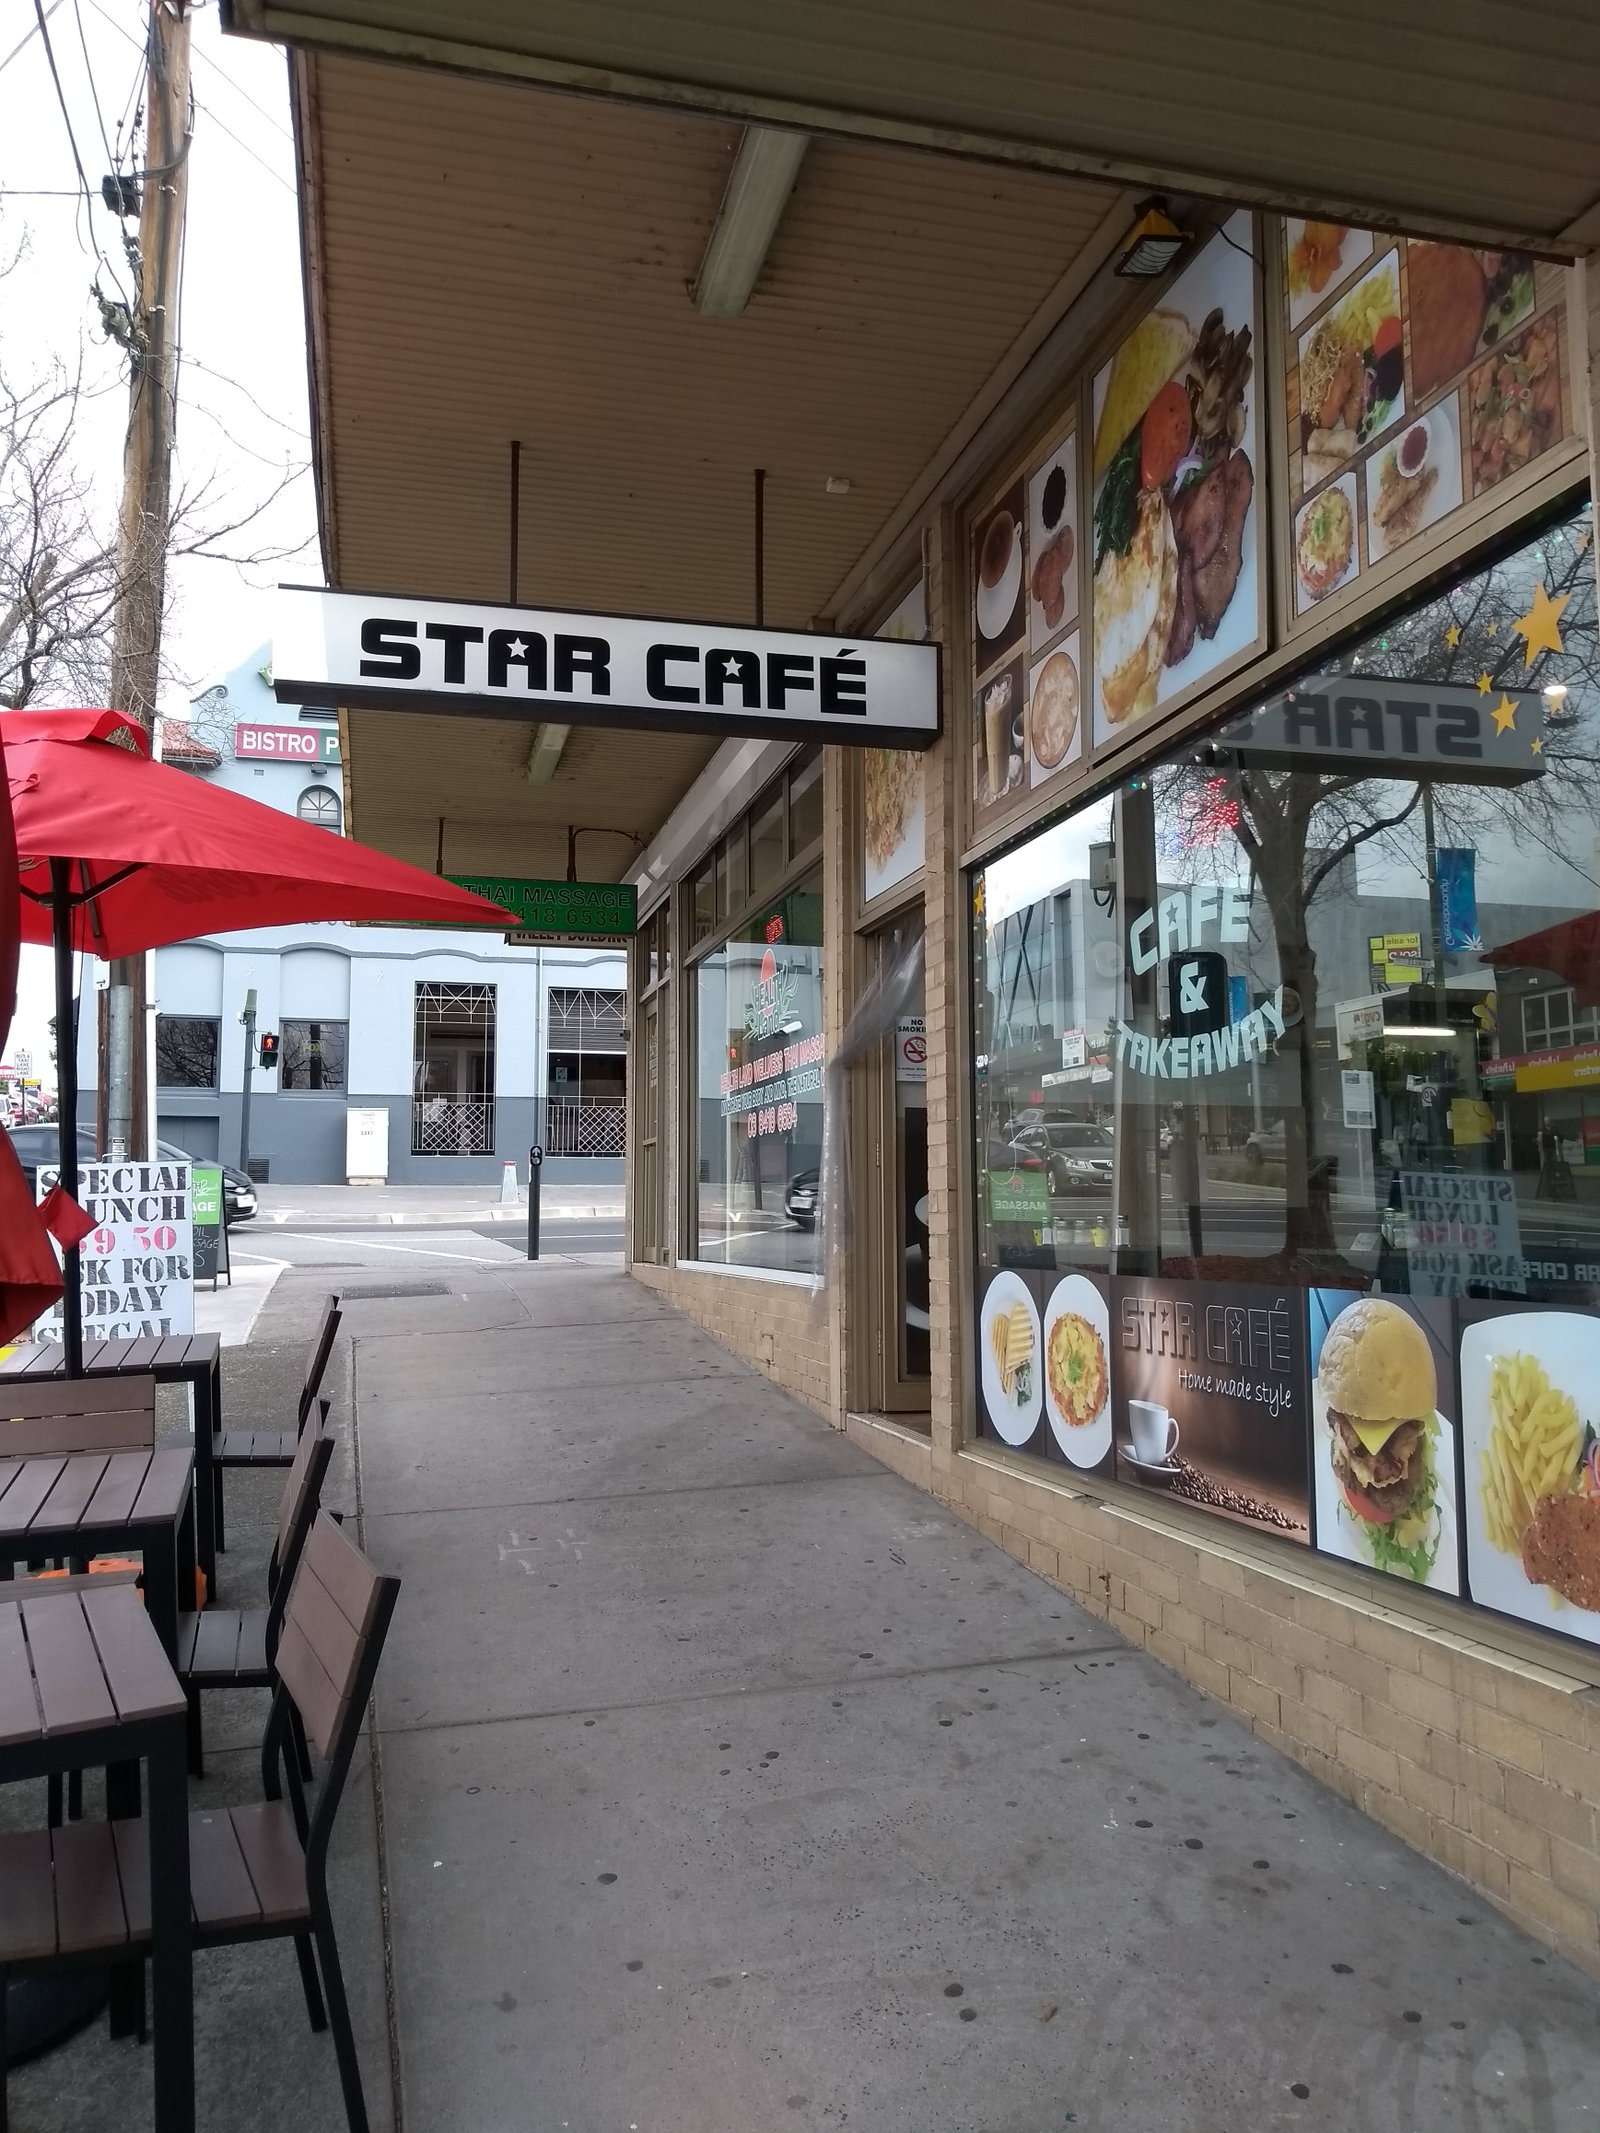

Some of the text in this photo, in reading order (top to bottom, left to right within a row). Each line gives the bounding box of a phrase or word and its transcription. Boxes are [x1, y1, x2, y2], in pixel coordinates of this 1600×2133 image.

[360, 618, 867, 716] STAR CAFÉ
[243, 730, 316, 754] BISTRO
[523, 887, 631, 909] MASSAGE
[566, 909, 621, 927] 6534
[1130, 886, 1251, 976] CAFE
[1180, 962, 1209, 1014] &
[1117, 983, 1286, 1079] TAKEAWAY
[85, 1196, 187, 1223] UNCH
[121, 1254, 192, 1284] FOR
[1122, 1297, 1291, 1372] STAR CAFÉ
[1178, 1368, 1292, 1417] Home made style
